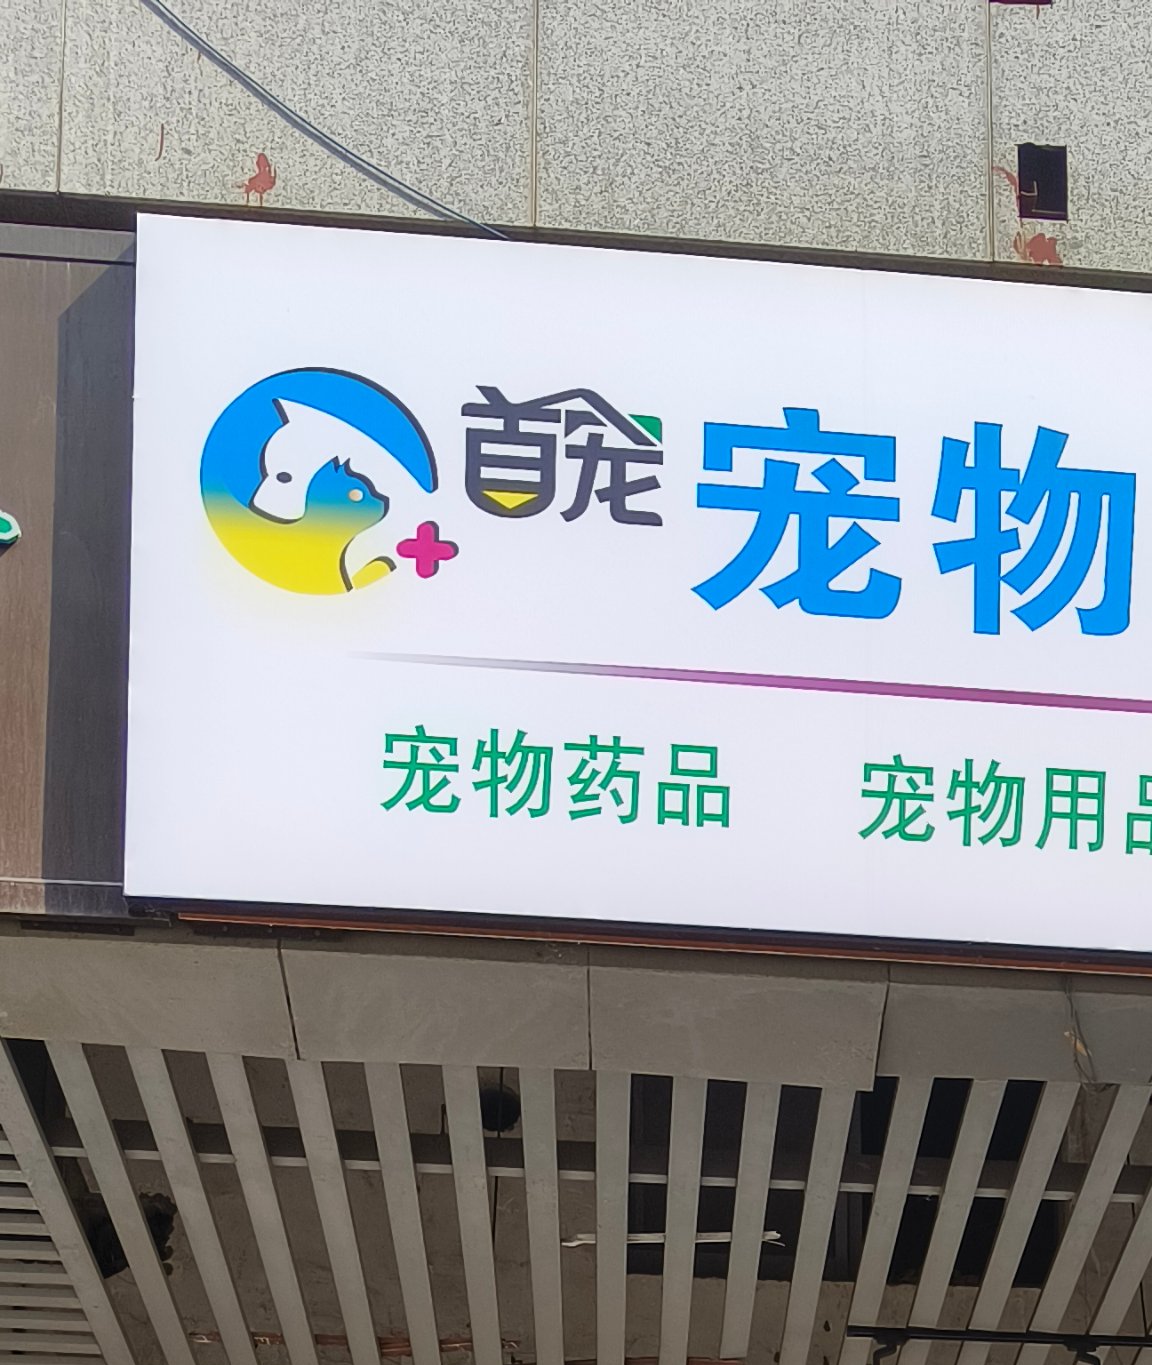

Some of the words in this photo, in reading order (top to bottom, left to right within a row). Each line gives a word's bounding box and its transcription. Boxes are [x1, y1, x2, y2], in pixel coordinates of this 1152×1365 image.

[461, 385, 663, 527] 首宠
[380, 725, 731, 828] 宠物药品
